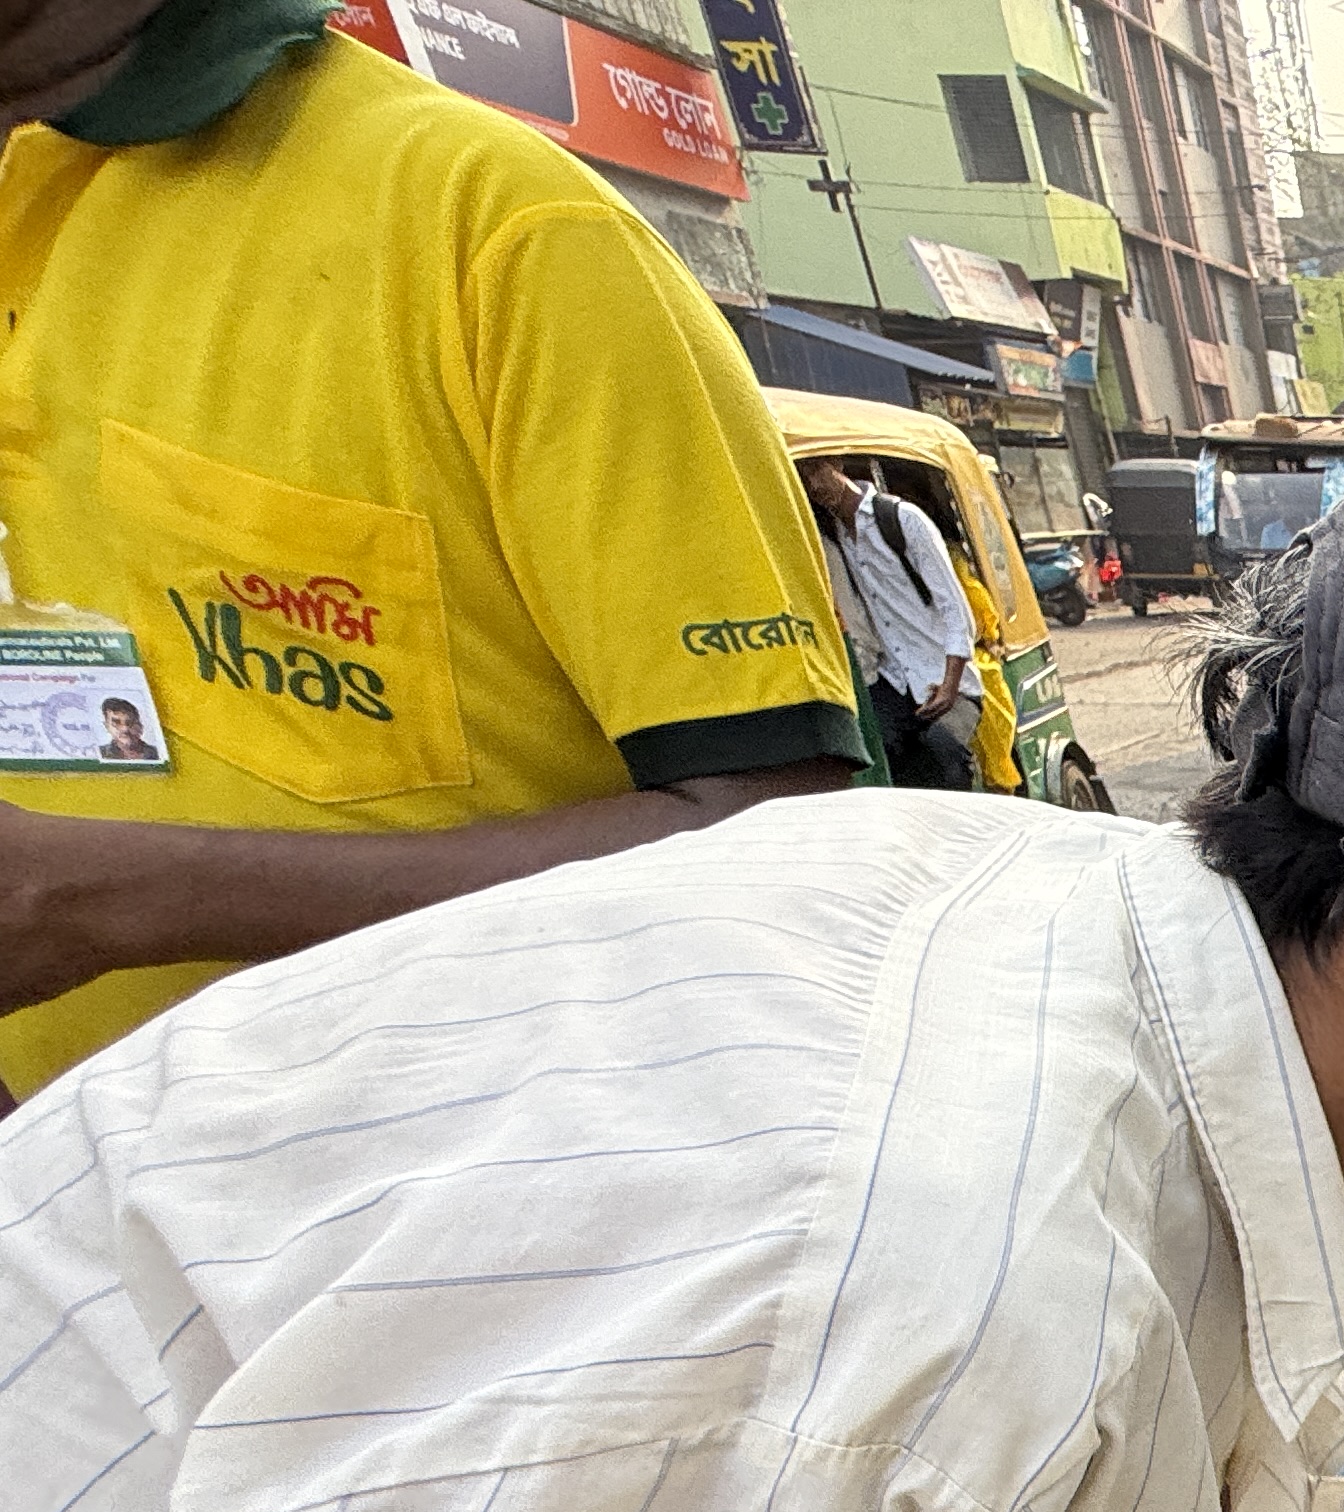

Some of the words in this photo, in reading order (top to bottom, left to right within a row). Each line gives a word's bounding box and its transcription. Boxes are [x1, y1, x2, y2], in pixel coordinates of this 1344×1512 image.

[601, 62, 669, 120] গোল্ড
[665, 85, 721, 140] লোন
[219, 570, 382, 646] আমি
[168, 587, 393, 721] Khas
